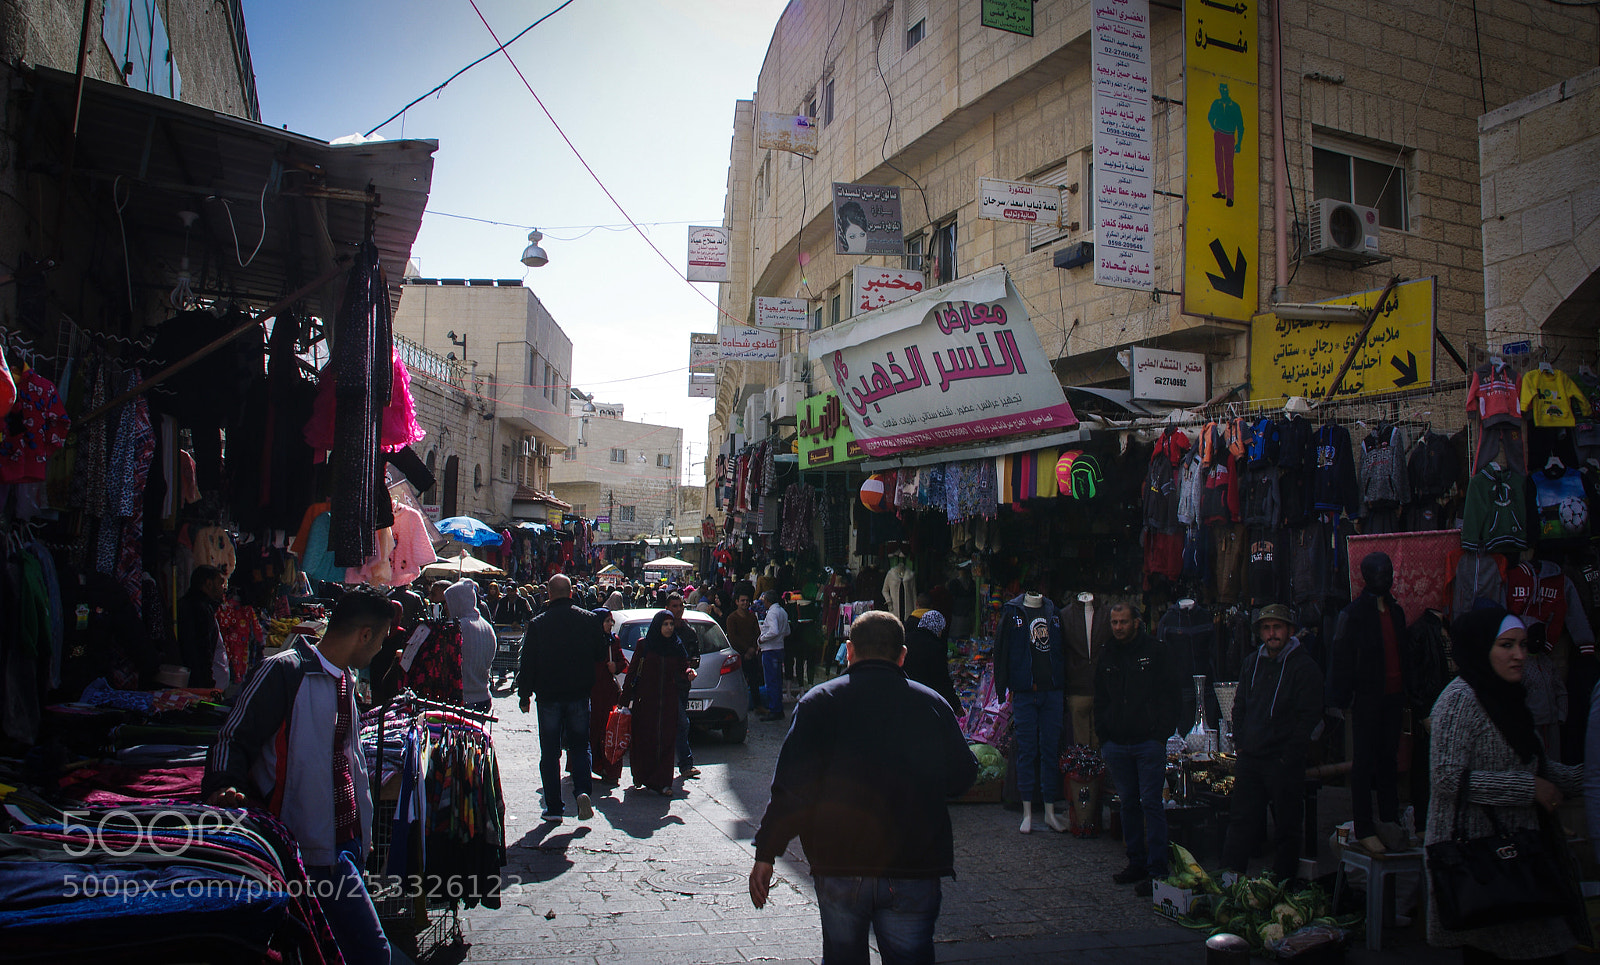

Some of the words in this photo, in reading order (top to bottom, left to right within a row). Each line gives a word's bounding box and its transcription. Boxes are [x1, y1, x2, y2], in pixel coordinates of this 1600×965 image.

[1195, 18, 1248, 53] مفرق
[1132, 72, 1148, 84] يوسف
[1100, 106, 1118, 118] عليان
[1008, 185, 1034, 196] الدكتورة
[1101, 184, 1117, 195] عليان
[1130, 189, 1147, 200] محمود
[1043, 201, 1057, 211] نعمة
[1118, 221, 1134, 231] محمود
[1101, 258, 1127, 272] شحادة
[1128, 263, 1150, 275] شادي
[861, 273, 923, 293] مختبر
[787, 305, 806, 315] يوسف
[933, 300, 1008, 336] معارض
[722, 337, 751, 349] شحادة
[1368, 326, 1400, 348] ملابس
[751, 338, 777, 351] شادي
[1309, 338, 1334, 360] رجالي
[932, 328, 1028, 393] النسر
[1137, 358, 1159, 373] الطبي
[1183, 361, 1202, 375] مختبر
[1281, 364, 1310, 383] منزلية
[1310, 357, 1334, 379] أدوات
[845, 344, 932, 428] الذهبي
[1000, 393, 1022, 408] تجهيز
